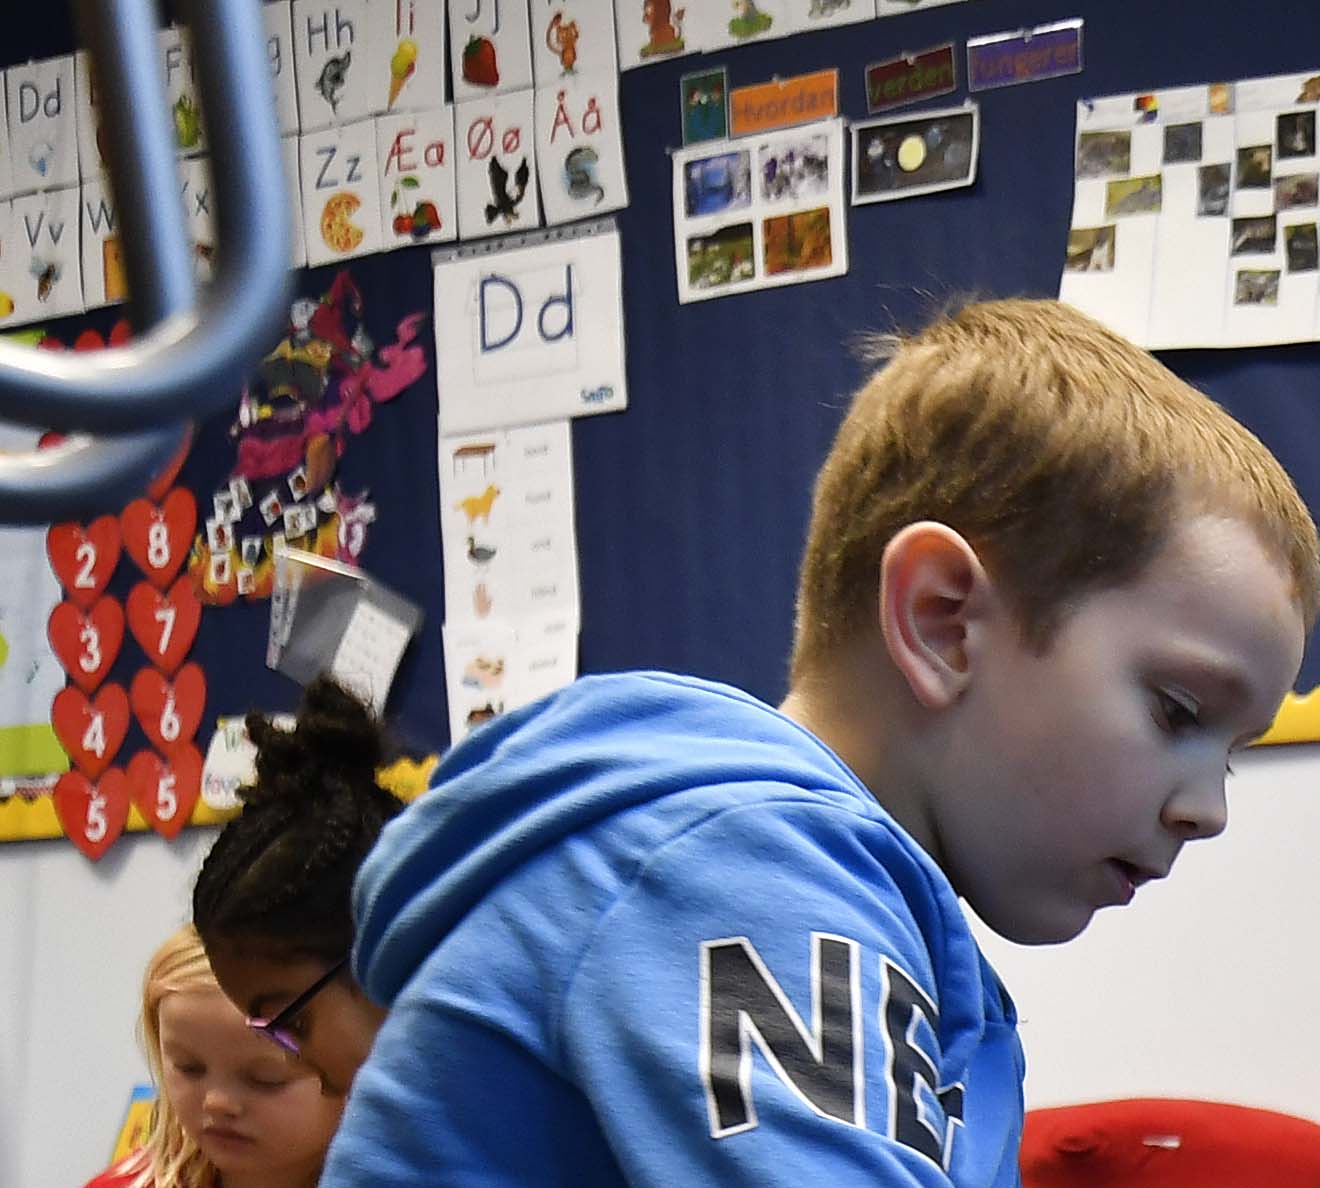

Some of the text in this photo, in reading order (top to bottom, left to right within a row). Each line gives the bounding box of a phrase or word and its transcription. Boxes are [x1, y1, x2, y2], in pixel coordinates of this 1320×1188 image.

[306, 9, 354, 56] Hh
[19, 78, 61, 124] Dd
[466, 115, 521, 161] Øø
[315, 145, 362, 190] Zz
[25, 212, 64, 247] Vv
[479, 264, 575, 353] Dd
[75, 543, 96, 588] 2
[148, 526, 169, 569] 8
[80, 630, 101, 674] 3
[154, 609, 176, 656] 7
[82, 711, 106, 759] 4
[160, 698, 181, 742] 6
[157, 772, 177, 821] 5
[85, 797, 108, 843] 5
